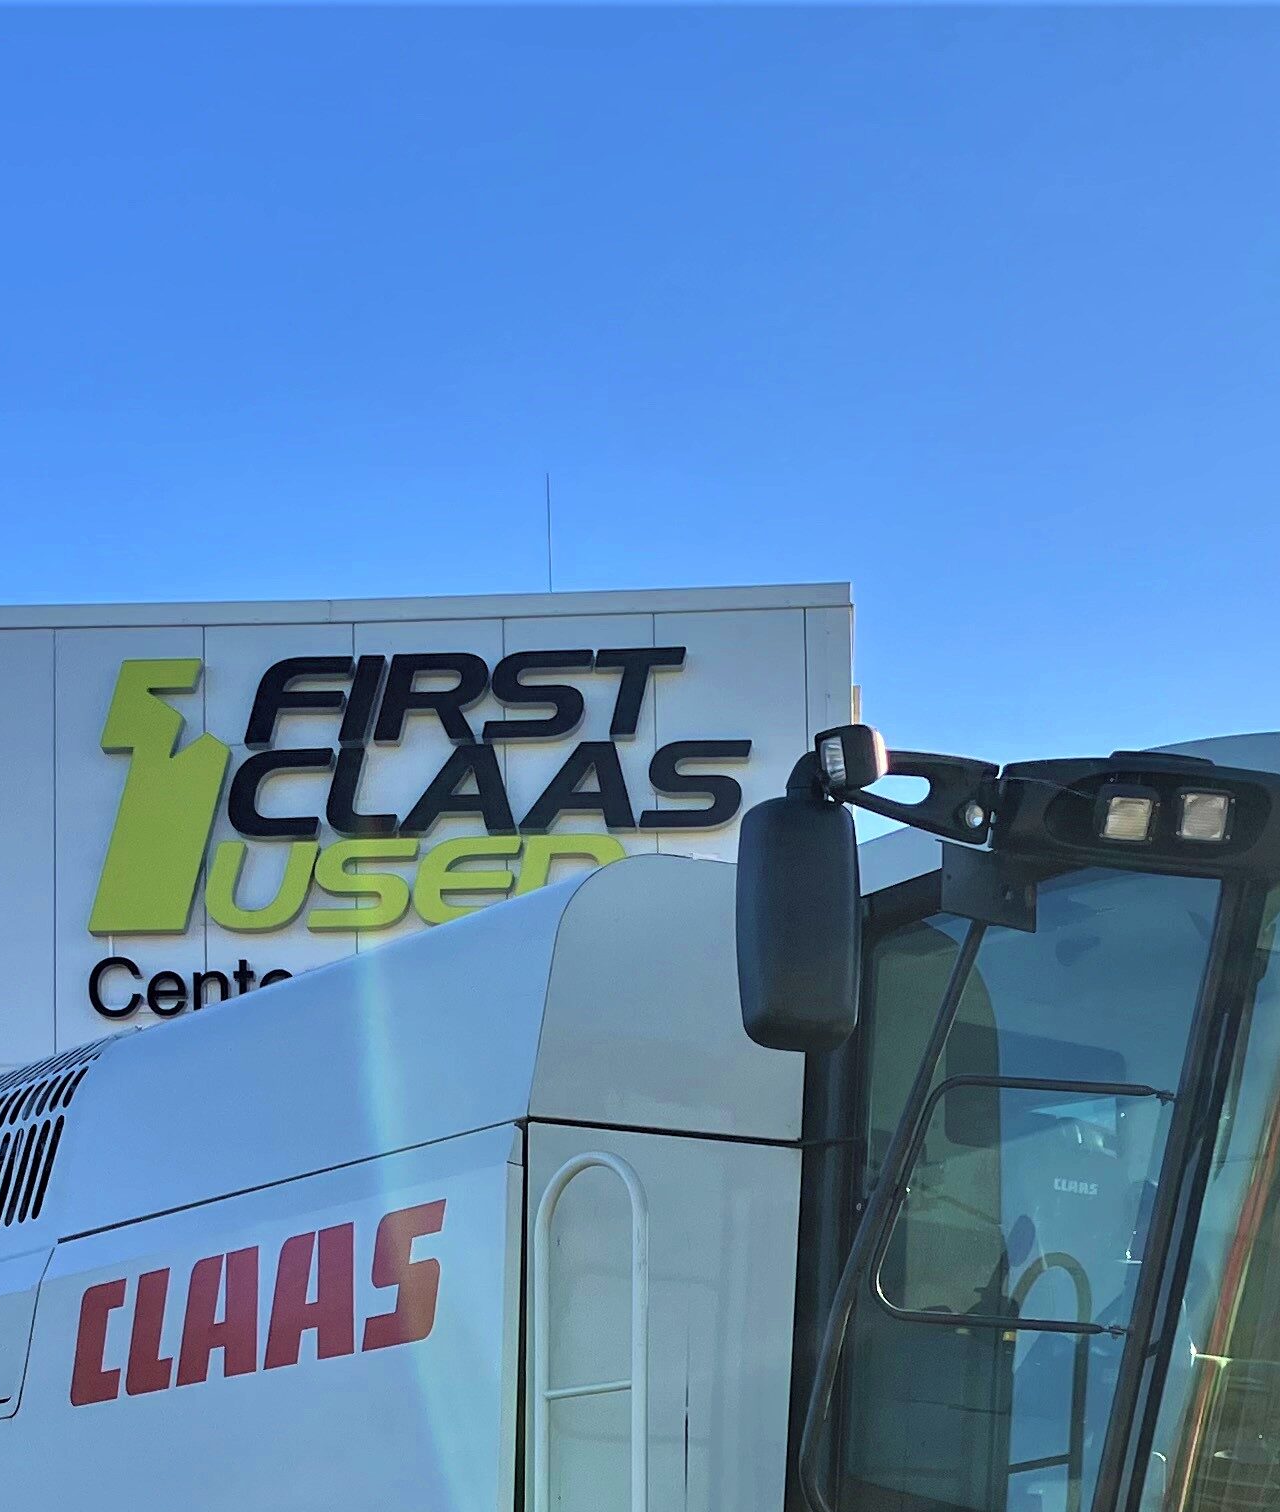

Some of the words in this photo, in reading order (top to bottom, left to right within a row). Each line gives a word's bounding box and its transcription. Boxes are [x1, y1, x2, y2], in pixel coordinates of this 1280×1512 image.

[244, 646, 686, 747] FIRST
[227, 739, 752, 837] CLAAS
[70, 1199, 447, 1406] CLAAS
